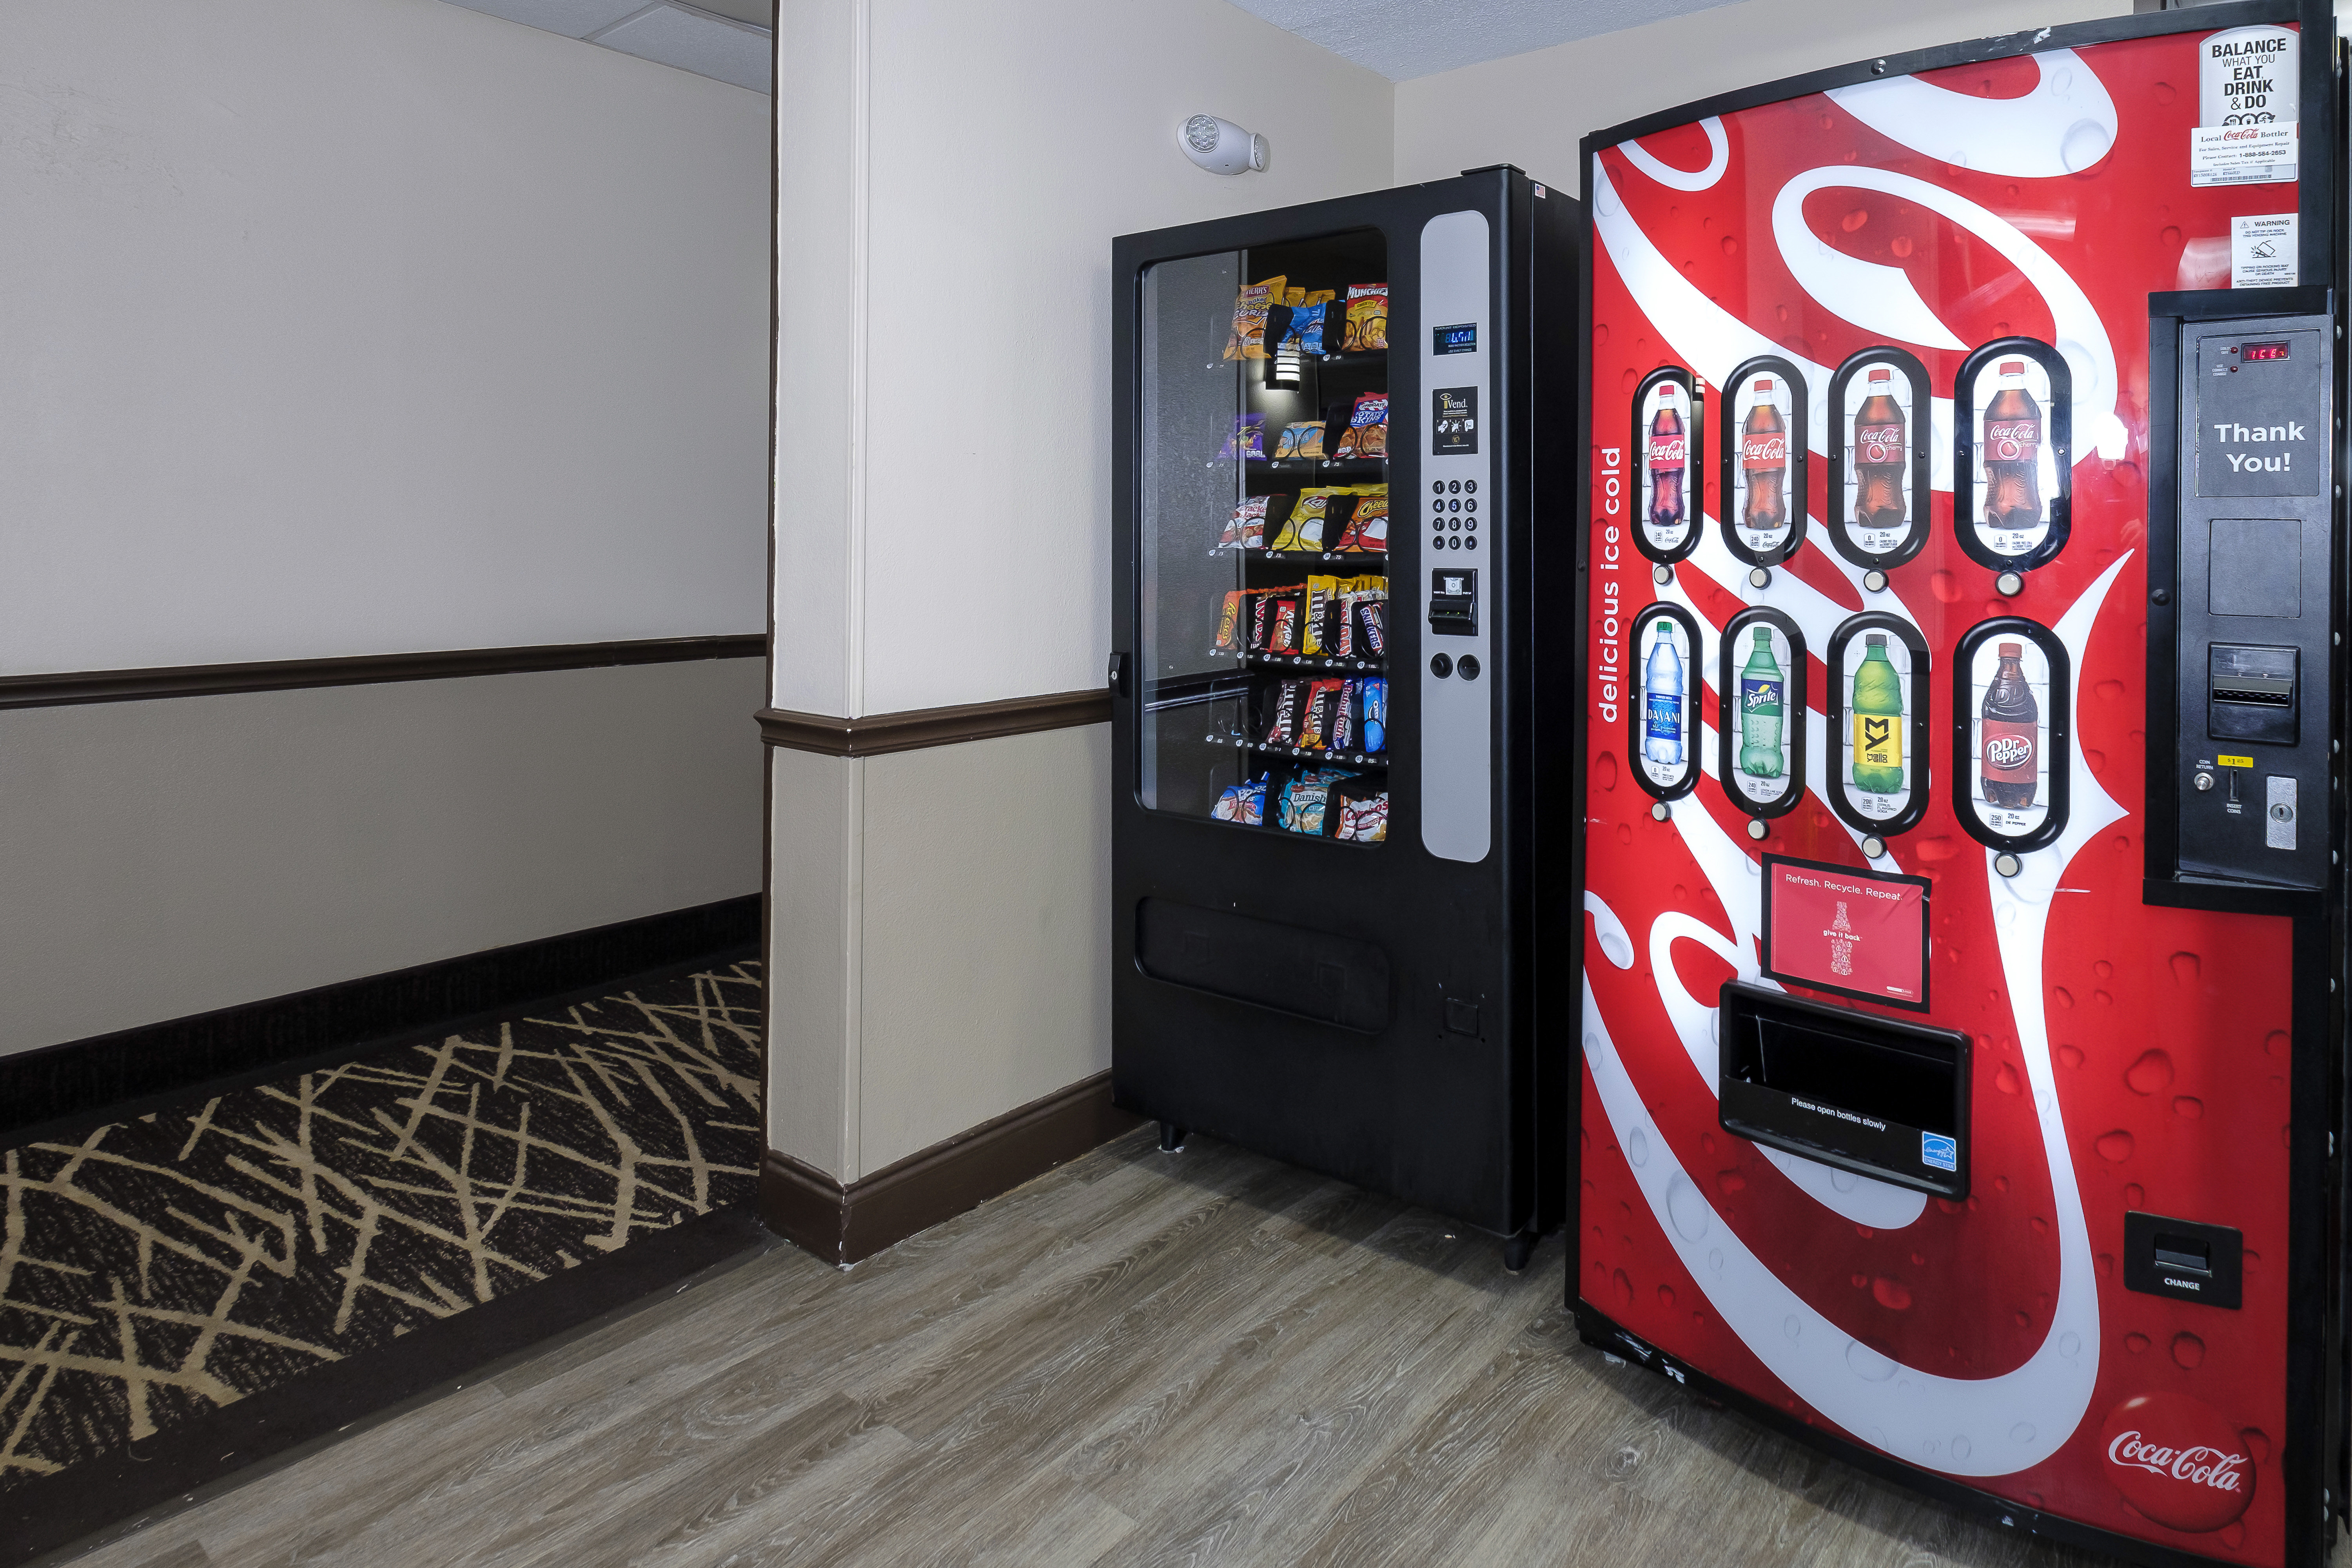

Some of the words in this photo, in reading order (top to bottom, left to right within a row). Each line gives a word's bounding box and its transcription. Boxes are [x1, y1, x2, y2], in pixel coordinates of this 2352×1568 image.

[2212, 38, 2286, 58] BALANCE
[2223, 56, 2251, 67] WHAT
[2255, 54, 2275, 64] YOU
[2224, 79, 2274, 96] DRINK
[2231, 97, 2241, 110] &
[2245, 94, 2266, 109] DO
[1860, 428, 1900, 444] Coca-Cola
[1990, 423, 2036, 441] Coca-Cola
[2214, 421, 2305, 443] Thank
[1649, 439, 1684, 461] Coca-Cola
[1743, 438, 1785, 461] Coca-Cola
[2226, 452, 2290, 472] You!
[1437, 483, 1440, 492] 1
[1452, 483, 1457, 491] 2
[1468, 482, 1473, 491] 3
[1601, 447, 1620, 515] cold
[1436, 502, 1441, 510] 4
[1452, 501, 1457, 510] 5
[1468, 501, 1473, 510] 6
[1436, 521, 1441, 529] 7
[1452, 520, 1456, 529] 8
[1468, 520, 1473, 529] 9
[1452, 539, 1456, 547] 0
[1600, 525, 1619, 570] ice
[1598, 581, 1619, 724] delicious
[1747, 691, 1776, 707] Sprite
[1648, 709, 1680, 724] DASANI
[1987, 740, 2029, 764] Pepper
[2002, 738, 2020, 751] Dr
[1294, 793, 1326, 802] Danish
[1786, 874, 1822, 887] Refresh.
[1824, 880, 1863, 895] Recycle.
[1866, 887, 1903, 901] Repeat.
[1823, 929, 1837, 937] give
[1845, 933, 1861, 941] back
[1792, 1097, 1815, 1111] Please
[1817, 1105, 1835, 1116] open
[1837, 1109, 1861, 1123] bottles
[1863, 1118, 1886, 1132] slowly
[2164, 1278, 2200, 1291] CHANGE
[2108, 1431, 2248, 1491] Coca-Cola
